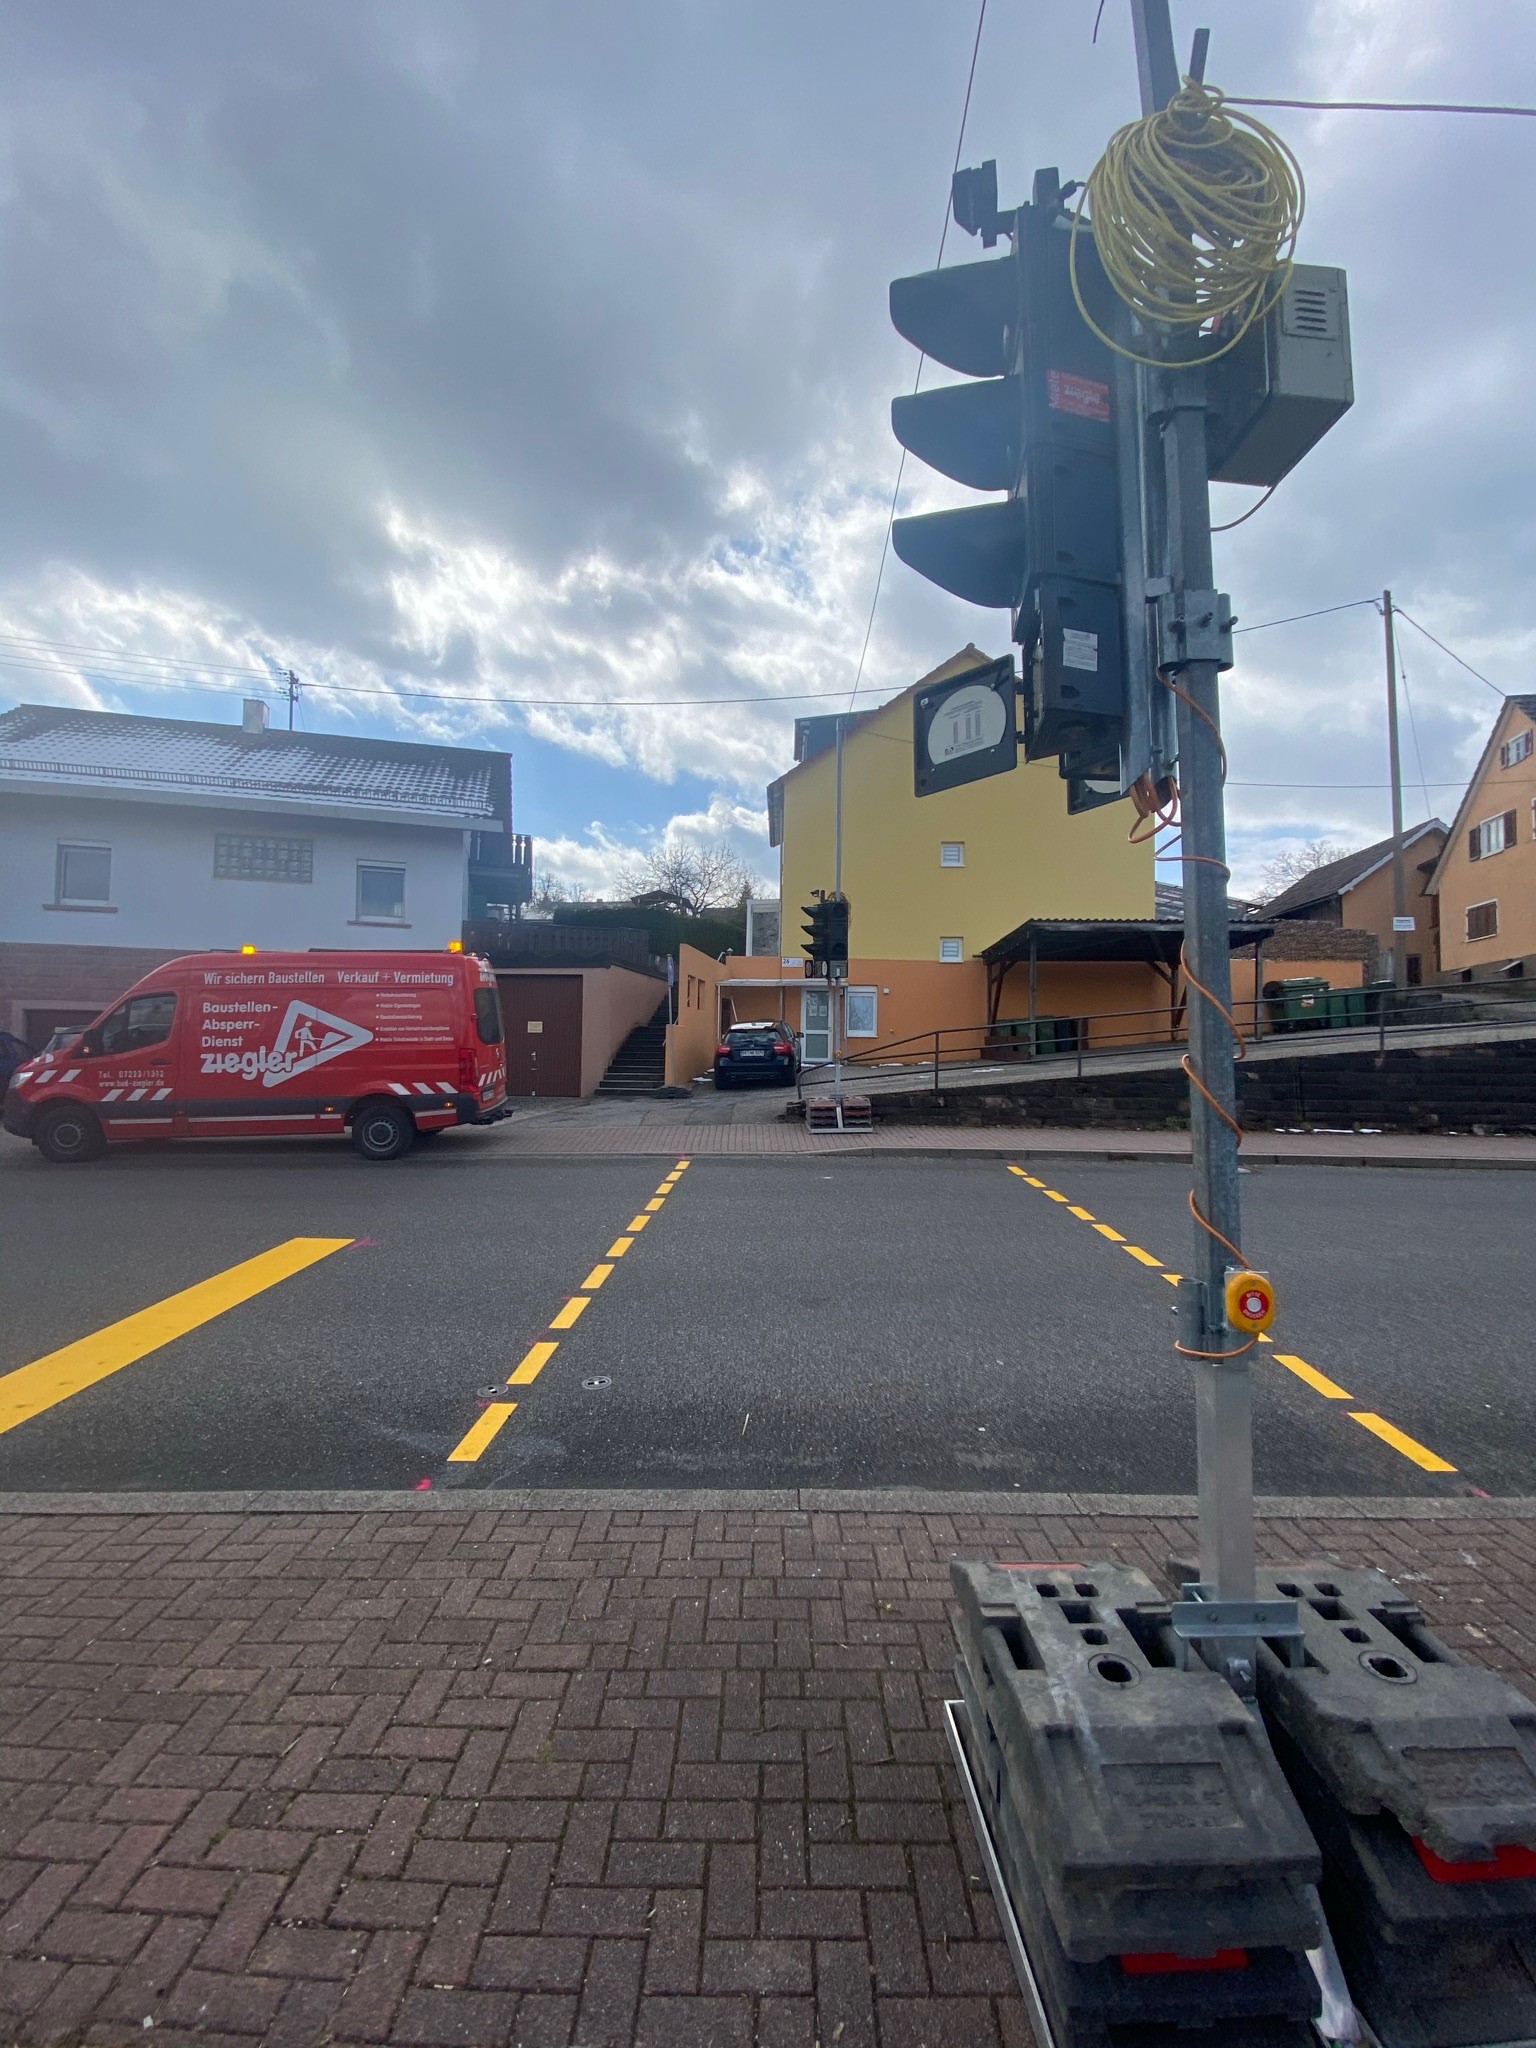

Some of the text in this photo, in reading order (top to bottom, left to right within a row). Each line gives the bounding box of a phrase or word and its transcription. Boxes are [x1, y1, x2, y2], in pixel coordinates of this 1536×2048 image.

[204, 971, 325, 985] Wir sichern Baustellen
[337, 971, 379, 983] Verkauf
[394, 971, 454, 986] Vermietung
[202, 1001, 279, 1013] Baustellen-
[202, 1018, 260, 1032] Absperr-
[201, 1036, 243, 1047] Dienst
[200, 1045, 298, 1080] ziegler
